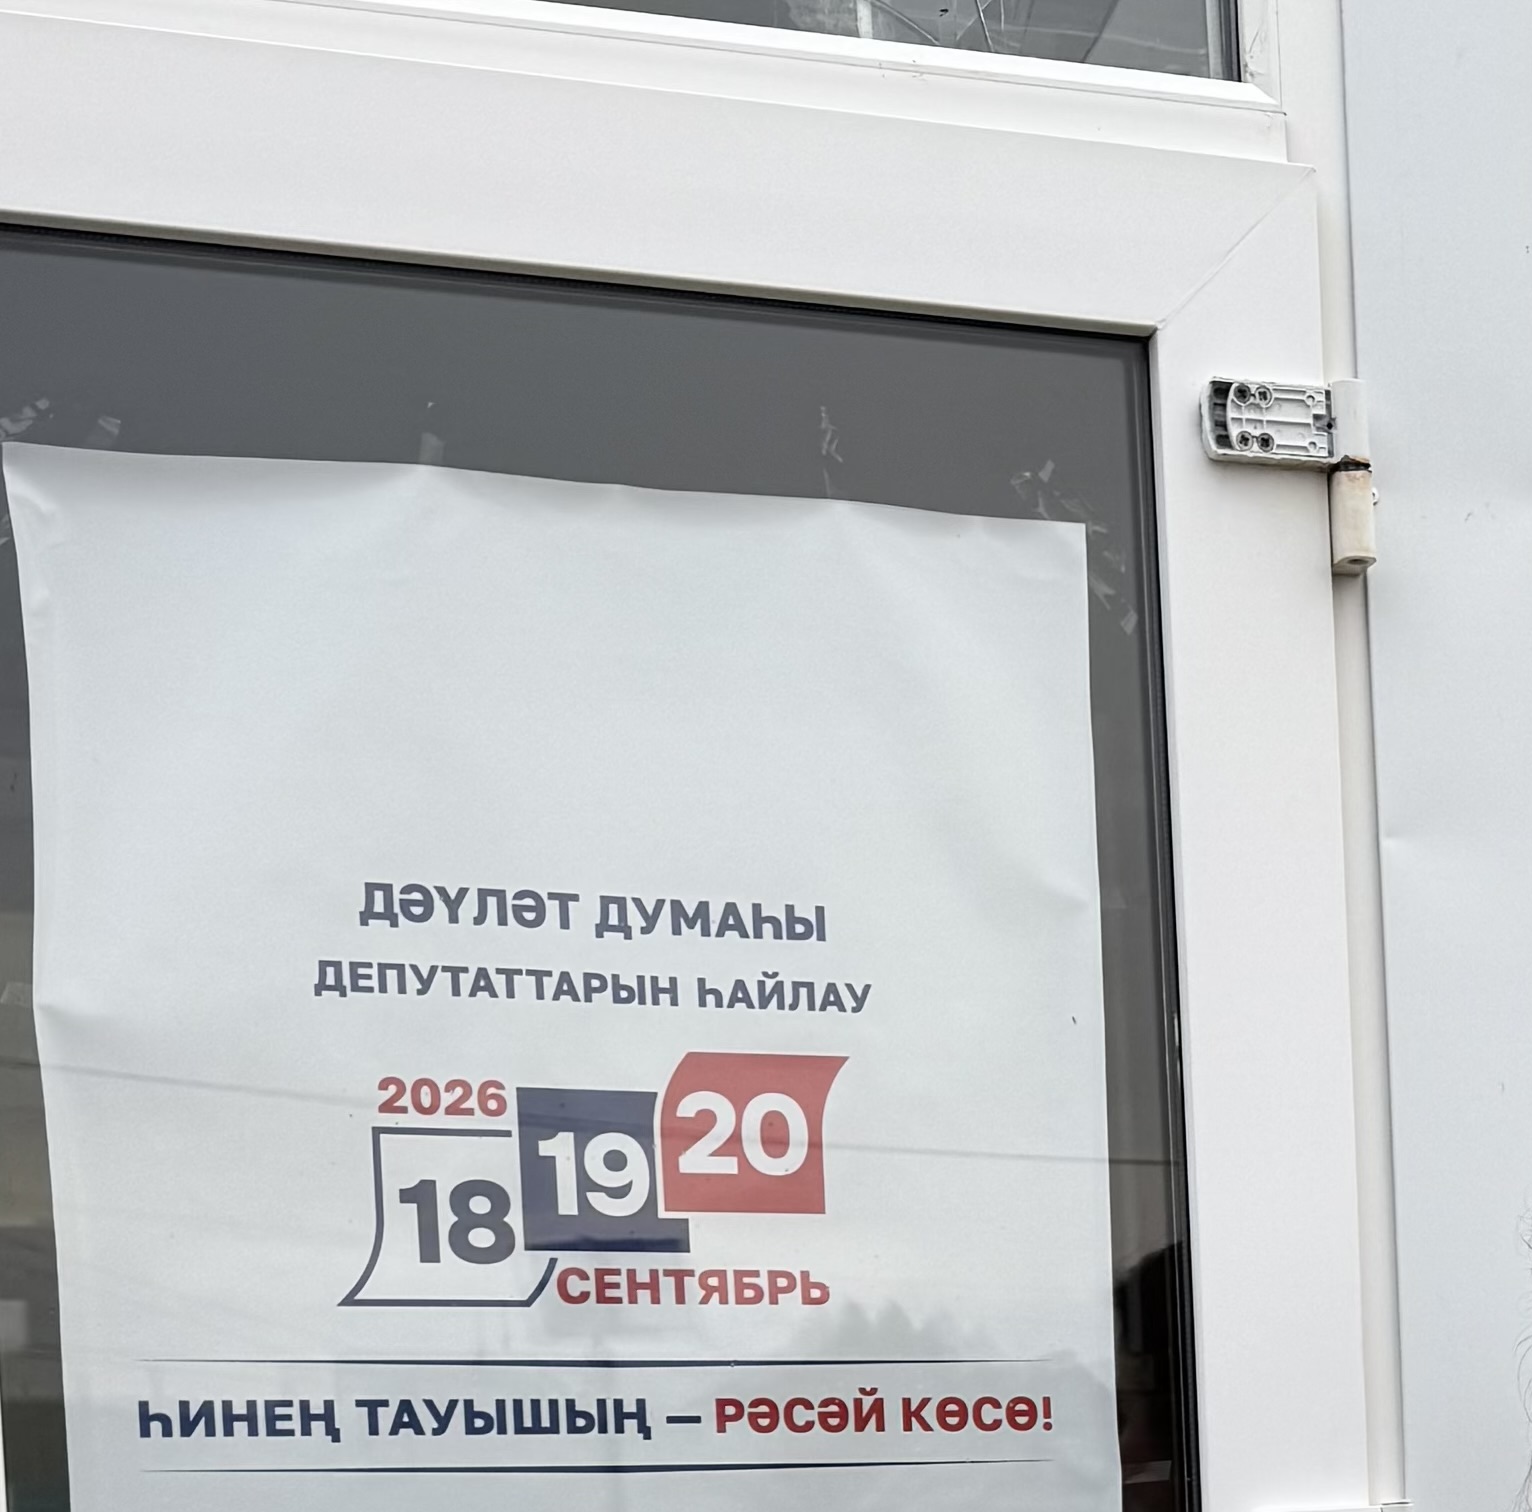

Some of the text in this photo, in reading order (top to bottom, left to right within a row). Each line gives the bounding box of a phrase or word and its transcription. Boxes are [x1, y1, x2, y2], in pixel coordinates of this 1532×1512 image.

[359, 881, 828, 942] ДӘҮЛӘТ ДУМАҺЫ
[313, 959, 873, 1014] ДЕПУТАТТАРЫН ҺАЙЛАУ
[377, 1076, 508, 1118] 2026
[398, 1090, 810, 1265] 18 19 20
[555, 1266, 831, 1307] СЕНТЯБРЬ
[138, 1399, 342, 1444] ҺИНЕҢ
[354, 1398, 652, 1441] ТАУЫШЫҢ
[715, 1387, 886, 1434] РӘСӘЙ
[901, 1395, 1054, 1433] КӨСӨ!
